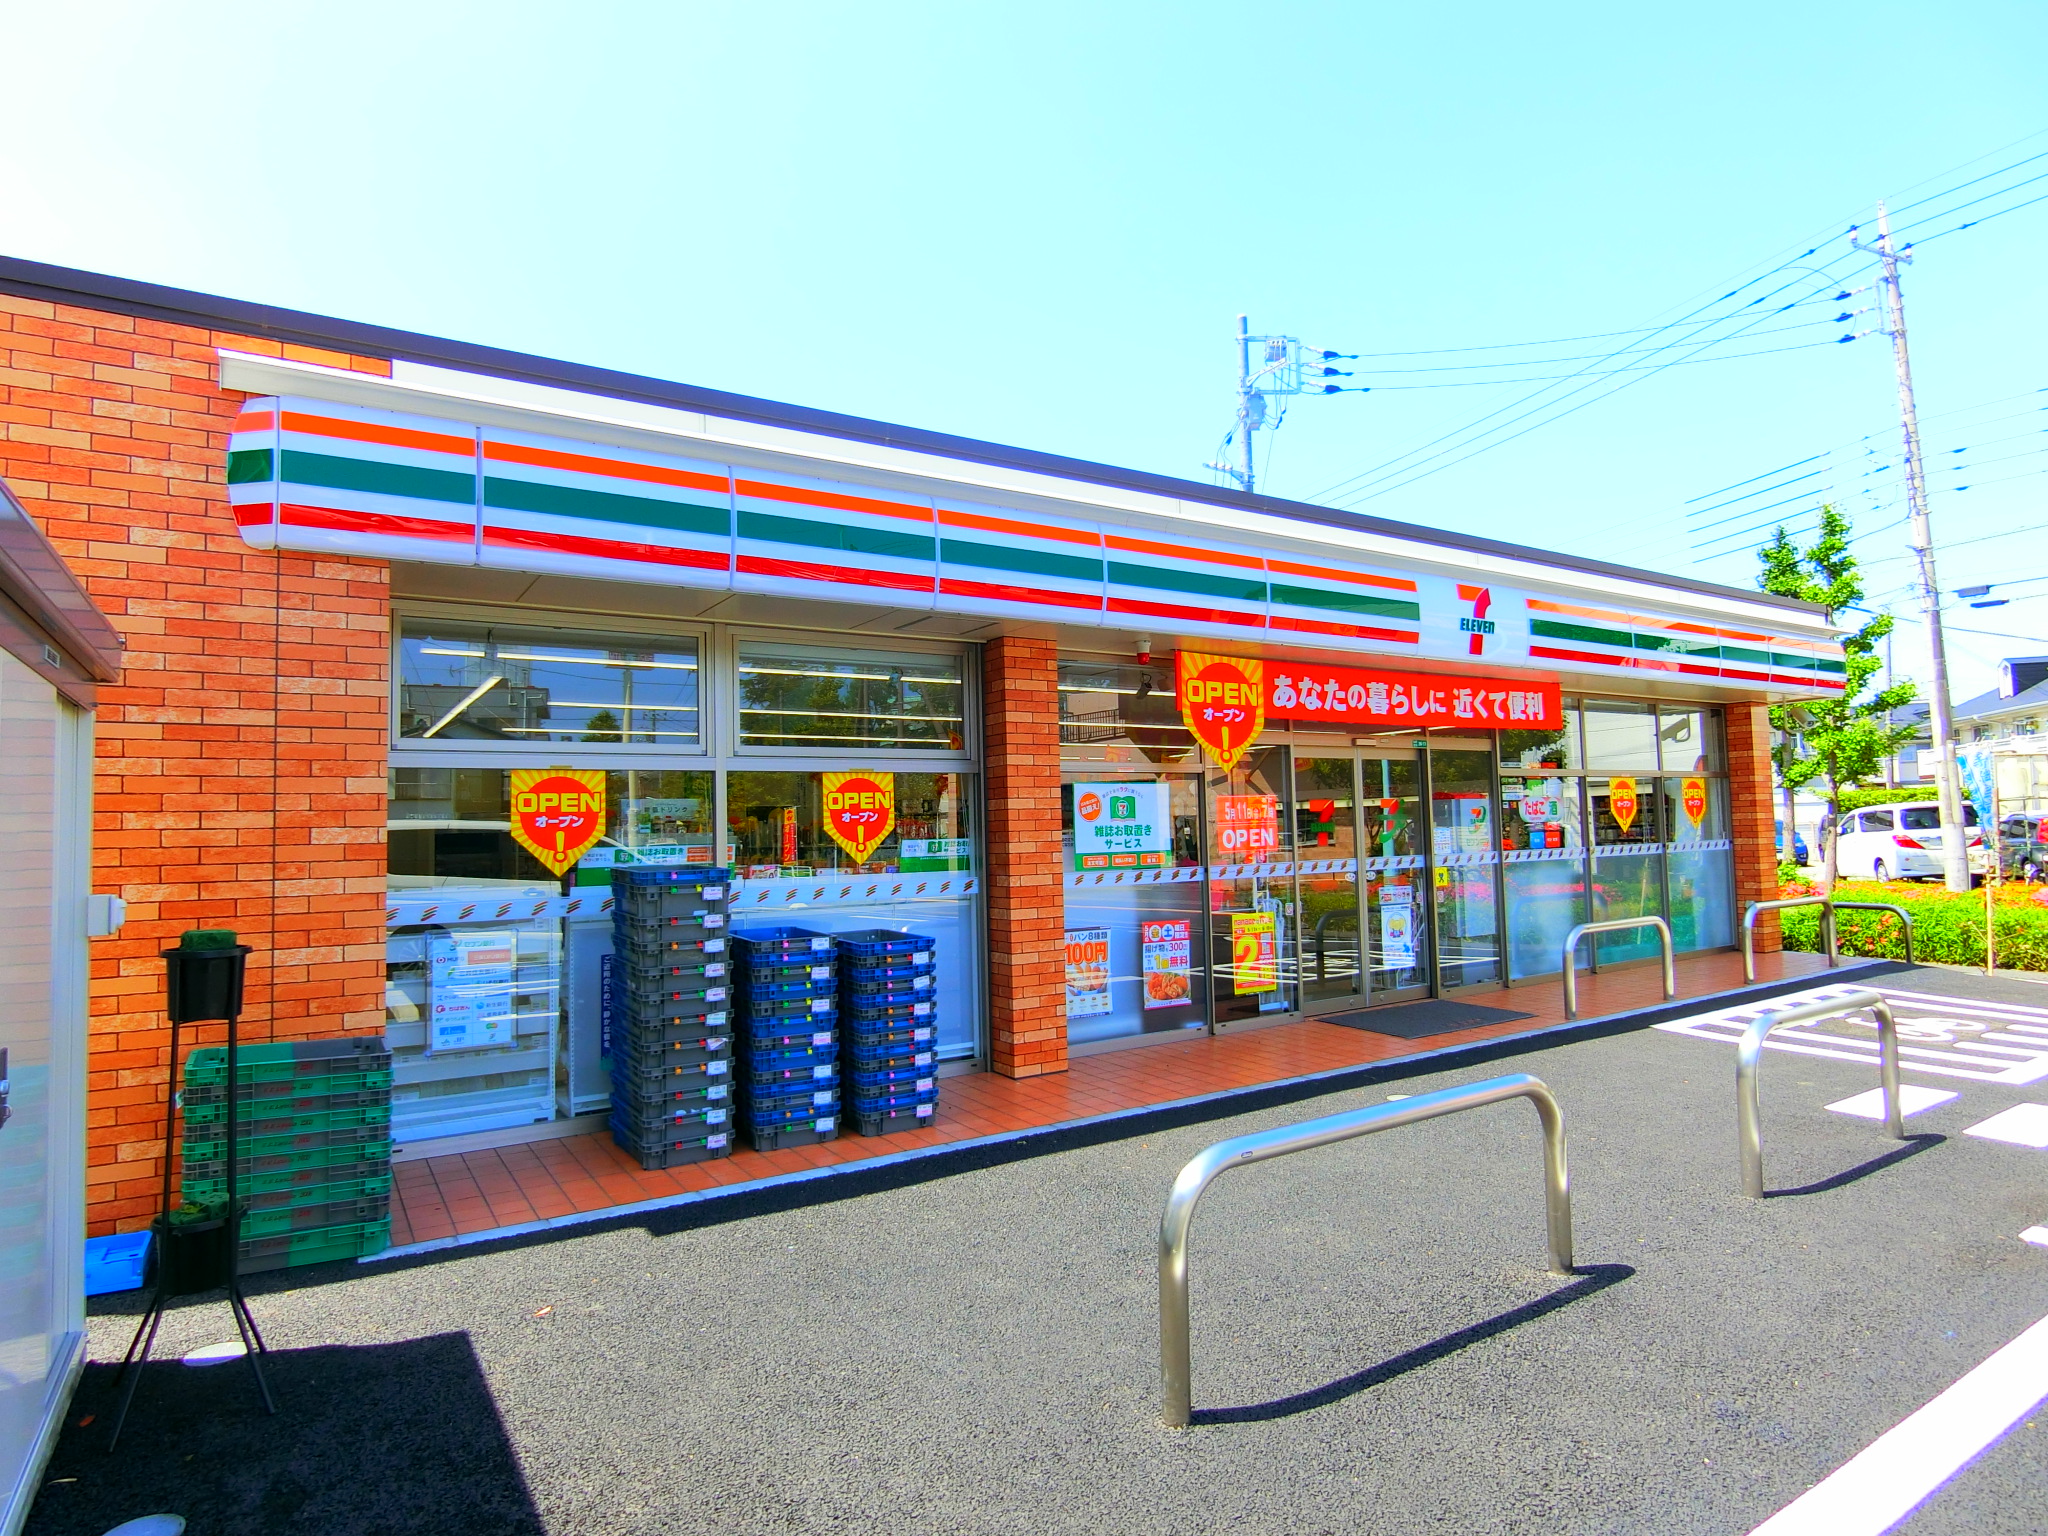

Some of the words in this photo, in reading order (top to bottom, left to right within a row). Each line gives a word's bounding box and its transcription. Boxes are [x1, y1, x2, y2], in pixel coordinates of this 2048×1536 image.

[1186, 678, 1258, 707] OPEN
[1272, 674, 1447, 716] あなたの暮らしに
[1453, 687, 1545, 721] 近くて便利
[1203, 707, 1245, 722] オープン
[827, 791, 891, 810] OPEN
[1611, 788, 1635, 799] OPEN
[1684, 788, 1705, 799] OPEN
[517, 792, 601, 813] OPEN
[1524, 801, 1546, 816] たばこ
[535, 815, 584, 828] オープン
[841, 811, 879, 822] オープン
[1094, 825, 1152, 838] 雑誌お取置き
[1222, 828, 1274, 849] OPEN
[1105, 838, 1142, 849] サービス
[1164, 926, 1173, 937] 土
[1065, 941, 1108, 965] 100円
